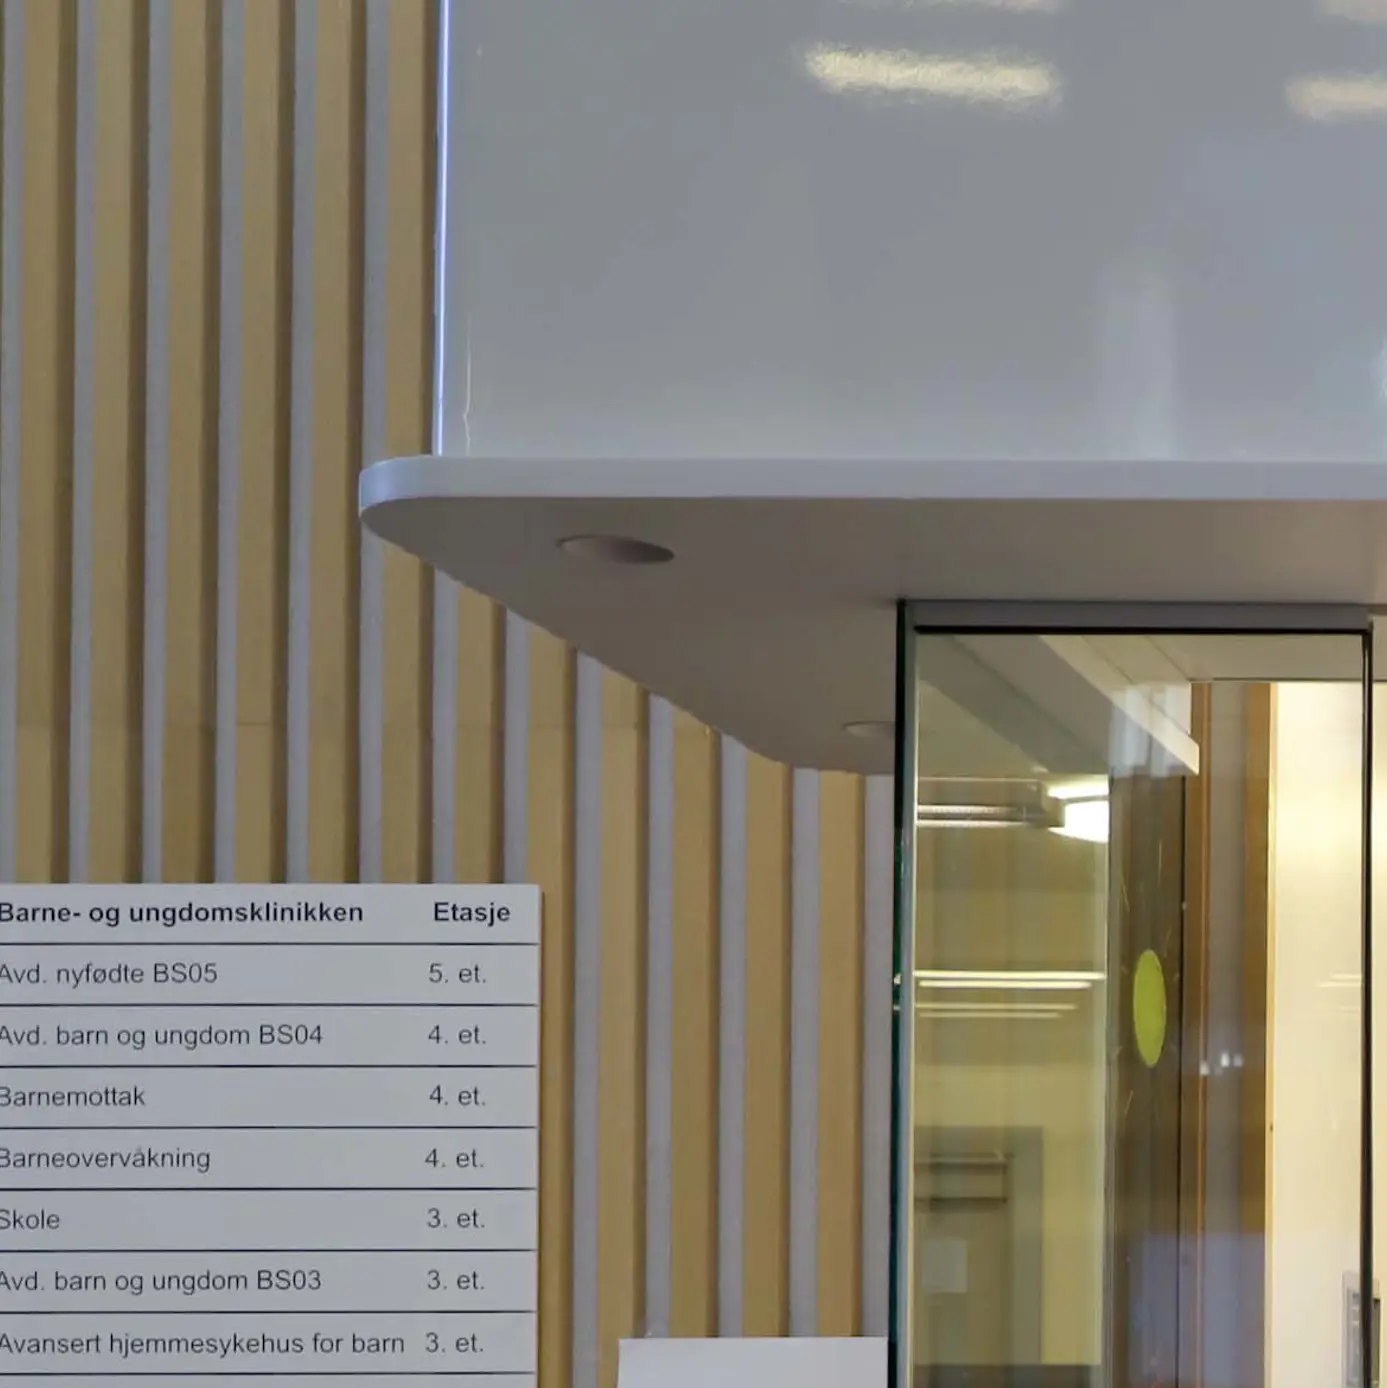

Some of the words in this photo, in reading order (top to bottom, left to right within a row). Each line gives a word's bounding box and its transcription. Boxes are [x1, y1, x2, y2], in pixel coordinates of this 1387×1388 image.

[89, 907, 120, 928] og
[130, 901, 363, 927] ungdomsklinikken
[434, 902, 511, 927] Etasje
[57, 962, 144, 989] nyfødte
[154, 962, 217, 983] BS05
[429, 963, 448, 983] 5.
[459, 964, 486, 983] et.
[57, 1025, 108, 1045] barn
[117, 1030, 145, 1050] og
[155, 1024, 250, 1051] ungdom
[260, 1024, 323, 1045] BS04
[428, 1025, 448, 1044] 4.
[459, 1025, 486, 1044] et.
[429, 1084, 448, 1105] 4.
[458, 1086, 485, 1106] et.
[425, 1148, 445, 1168] 4.
[456, 1149, 483, 1168] et.
[427, 1208, 447, 1228] 3.
[457, 1209, 485, 1228] et.
[55, 1271, 106, 1291] barn
[115, 1275, 143, 1296] og
[153, 1269, 247, 1295] ungdom
[257, 1269, 321, 1290] BS03
[428, 1269, 447, 1290] 3.
[457, 1271, 484, 1290] et.
[110, 1333, 303, 1359] hjemmesykehus
[312, 1332, 344, 1353] for
[352, 1332, 404, 1353] barn
[426, 1332, 445, 1353] 3.
[456, 1333, 483, 1353] et.
